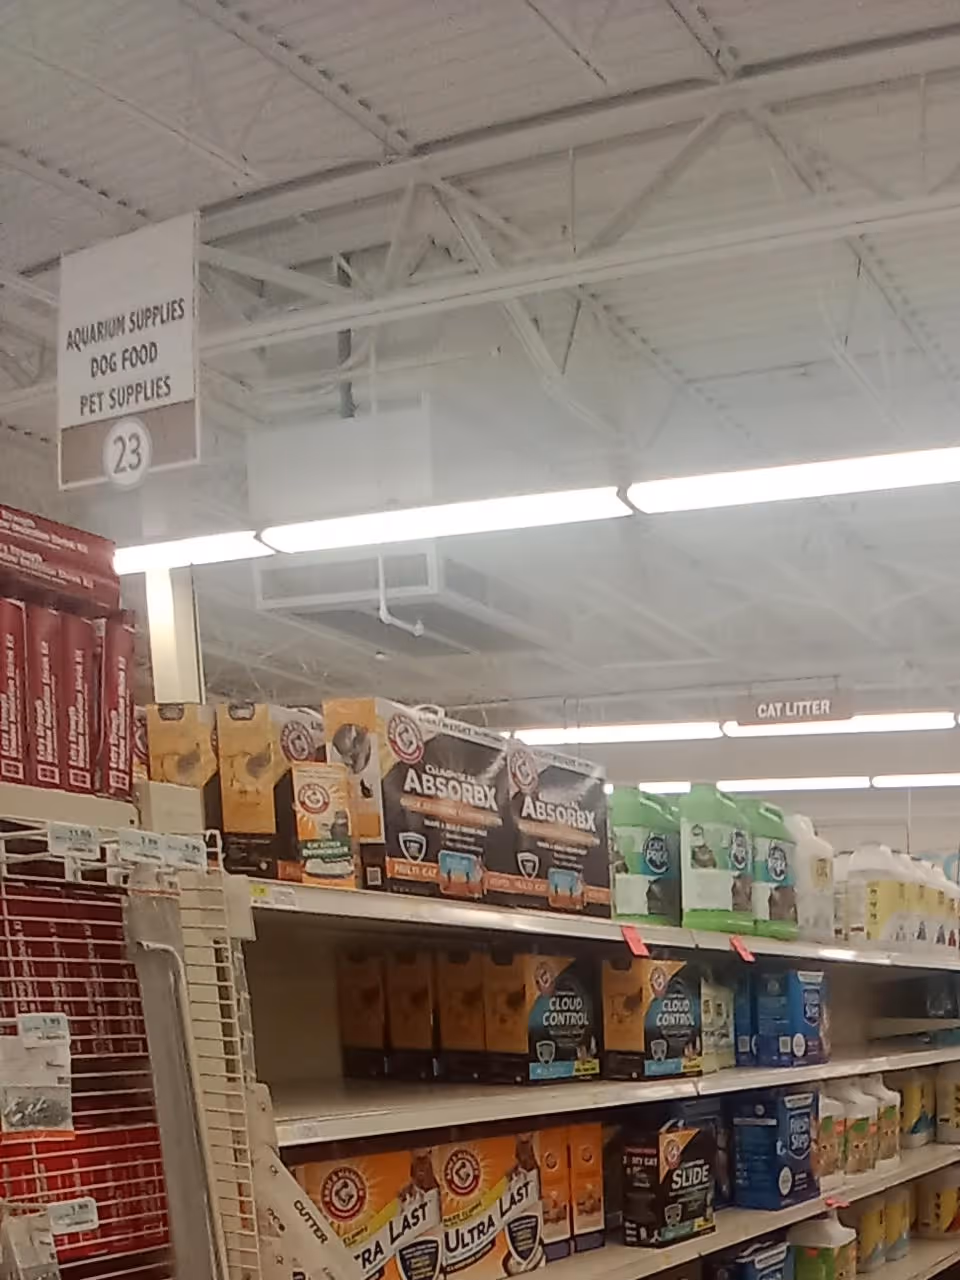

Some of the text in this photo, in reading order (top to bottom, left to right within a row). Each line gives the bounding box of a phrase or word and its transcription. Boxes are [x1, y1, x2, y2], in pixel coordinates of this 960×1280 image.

[66, 297, 186, 352] AQUARIUM SUPPLIES
[91, 341, 158, 378] DOG FOOD
[80, 376, 171, 416] PET SUPPLIES
[113, 432, 142, 474] 23
[757, 699, 831, 718] CAT LITTER
[403, 767, 498, 813] ABSORBX
[521, 794, 597, 833] ABSORBX
[542, 1012, 589, 1026] CONTROL
[549, 997, 584, 1011] CLOUD
[656, 1012, 695, 1027] CONTROL
[662, 1000, 690, 1012] CLOUD
[671, 1164, 710, 1190] SLIDE
[293, 1199, 329, 1245] CUTTER
[388, 1201, 429, 1245] LAST
[444, 1214, 496, 1252] ULTRA
[498, 1181, 531, 1217] LAST
